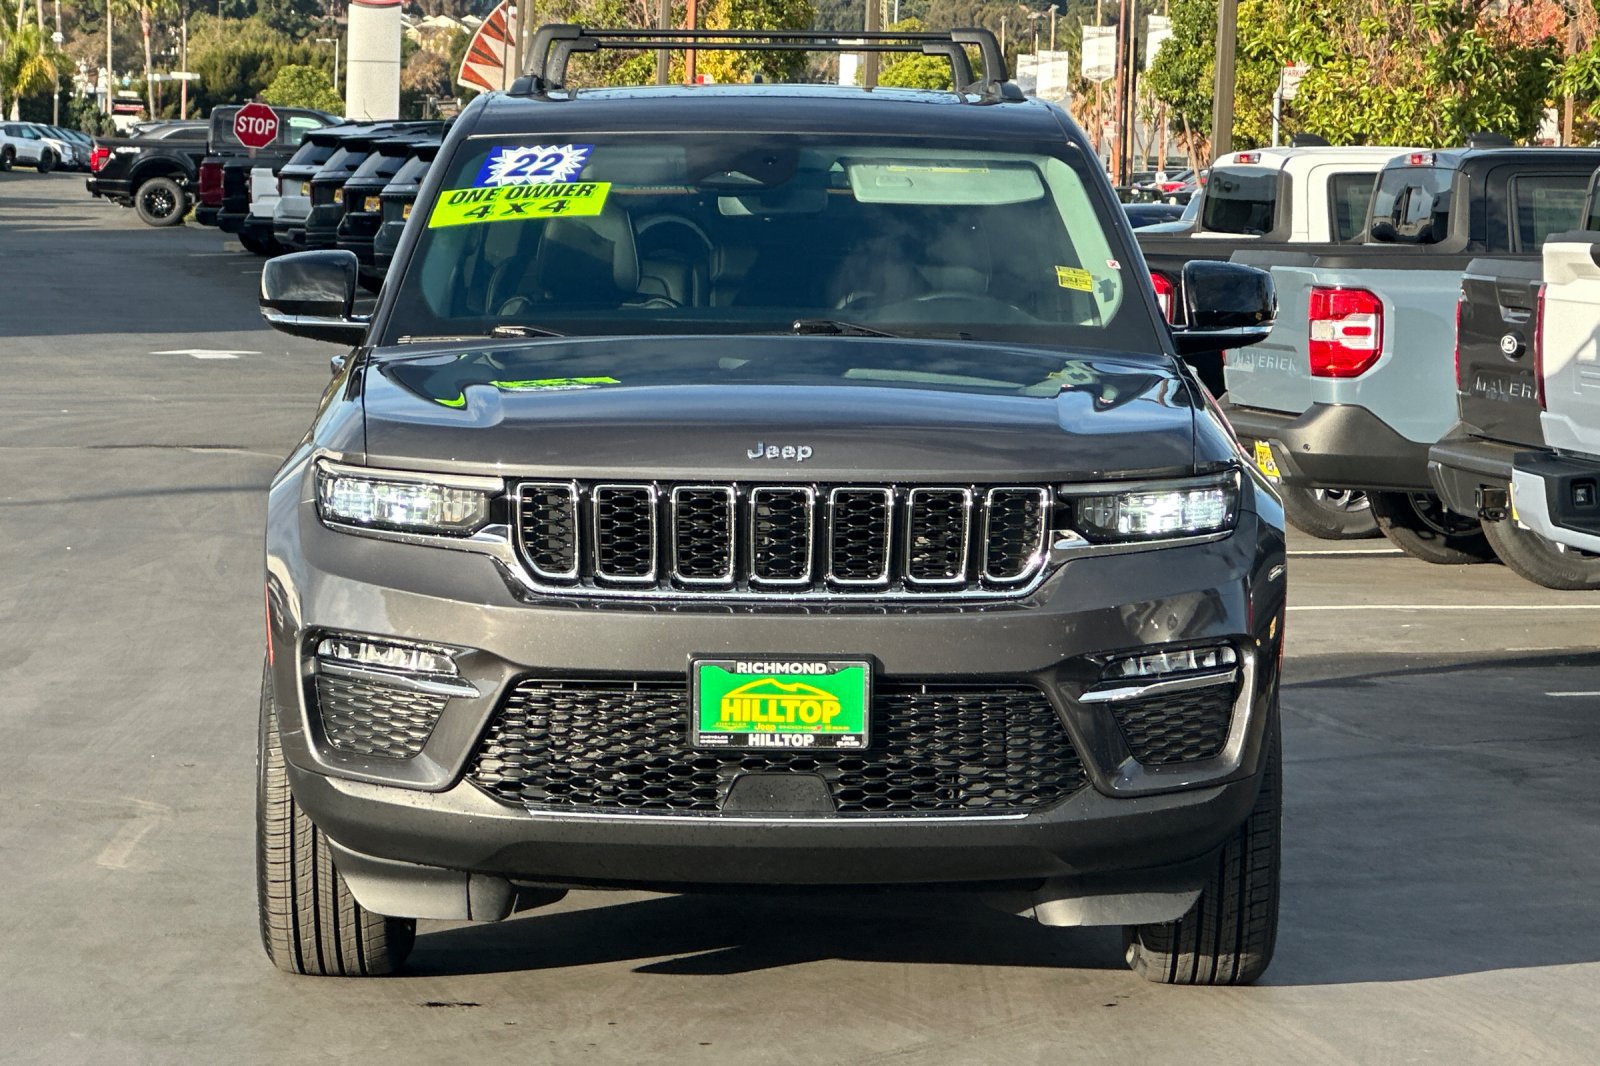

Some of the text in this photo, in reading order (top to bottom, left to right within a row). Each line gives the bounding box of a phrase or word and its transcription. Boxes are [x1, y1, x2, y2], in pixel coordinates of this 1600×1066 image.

[237, 116, 276, 135] STOP
[504, 153, 564, 177] 22
[448, 184, 597, 205] ONE OWNER
[747, 441, 813, 462] Jeep
[736, 662, 827, 675] RICHMOND
[720, 699, 841, 724] HILLTOP
[748, 733, 815, 747] HILLTOP
